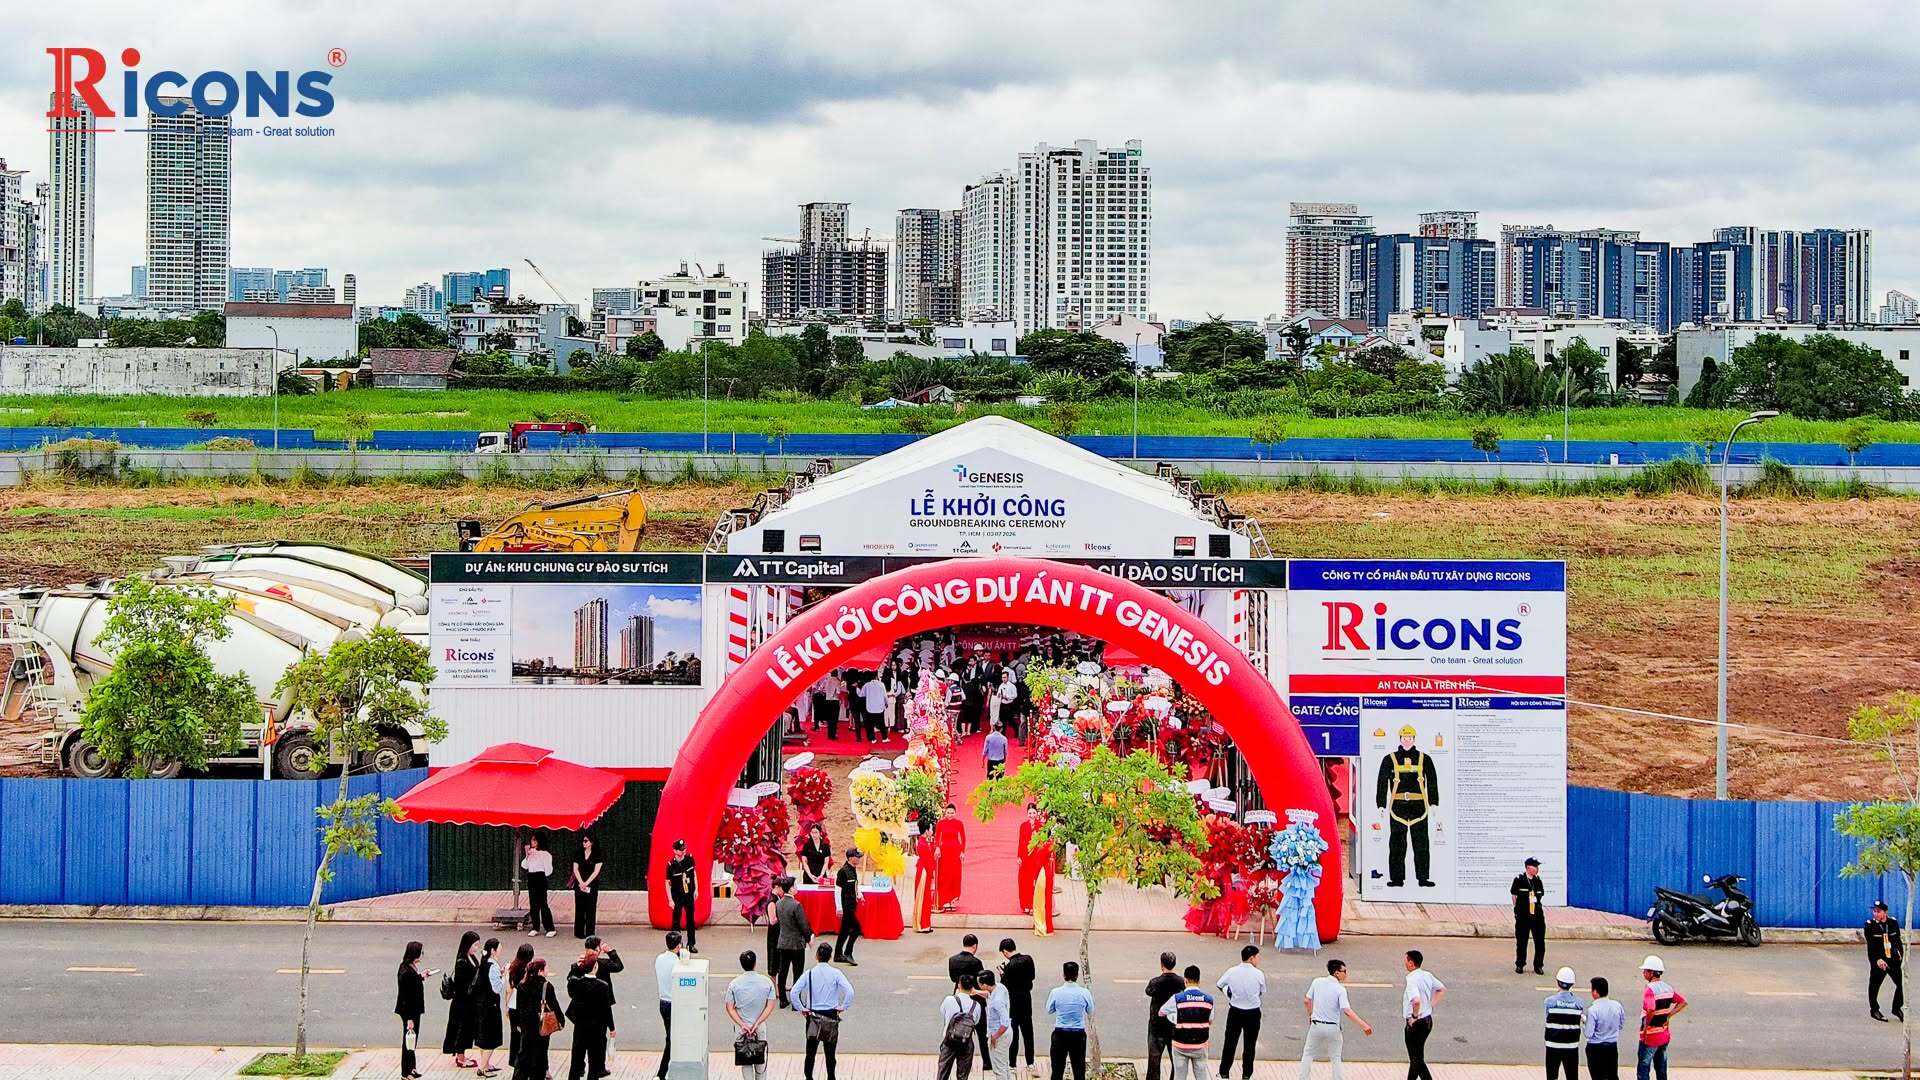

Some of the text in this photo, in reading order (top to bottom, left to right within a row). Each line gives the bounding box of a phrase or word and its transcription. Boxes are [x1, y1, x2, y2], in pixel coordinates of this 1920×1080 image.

[969, 473, 1024, 483] GENESIS
[911, 489, 1065, 517] LỄ KHỞI CÔNG
[909, 519, 1066, 529] GROUNDBREAKING CEREMONY
[465, 560, 668, 575] DỰ ÁN: KHU CHUNG CƯ ĐÀO SƯ TÍCH
[760, 560, 844, 579] TT Capital
[1128, 562, 1168, 582] ĐÀO
[1171, 563, 1198, 582] SƯ
[1201, 563, 1244, 582] TÍCH
[1353, 571, 1364, 580] TY
[1432, 571, 1446, 581] TƯ
[1466, 571, 1494, 582] DỰNG
[1495, 572, 1531, 581] RICONS
[765, 570, 1231, 690] LỄ KHỞI CÔNG DỰ ÁN TT GENESIS
[1430, 656, 1446, 664] One
[1447, 656, 1466, 664] team
[1472, 656, 1493, 664] Great
[1494, 656, 1523, 665] solution
[1377, 681, 1391, 690] AN
[1393, 680, 1419, 690] TOÀN
[1421, 680, 1432, 690] LÀ
[1321, 732, 1330, 750] 1
